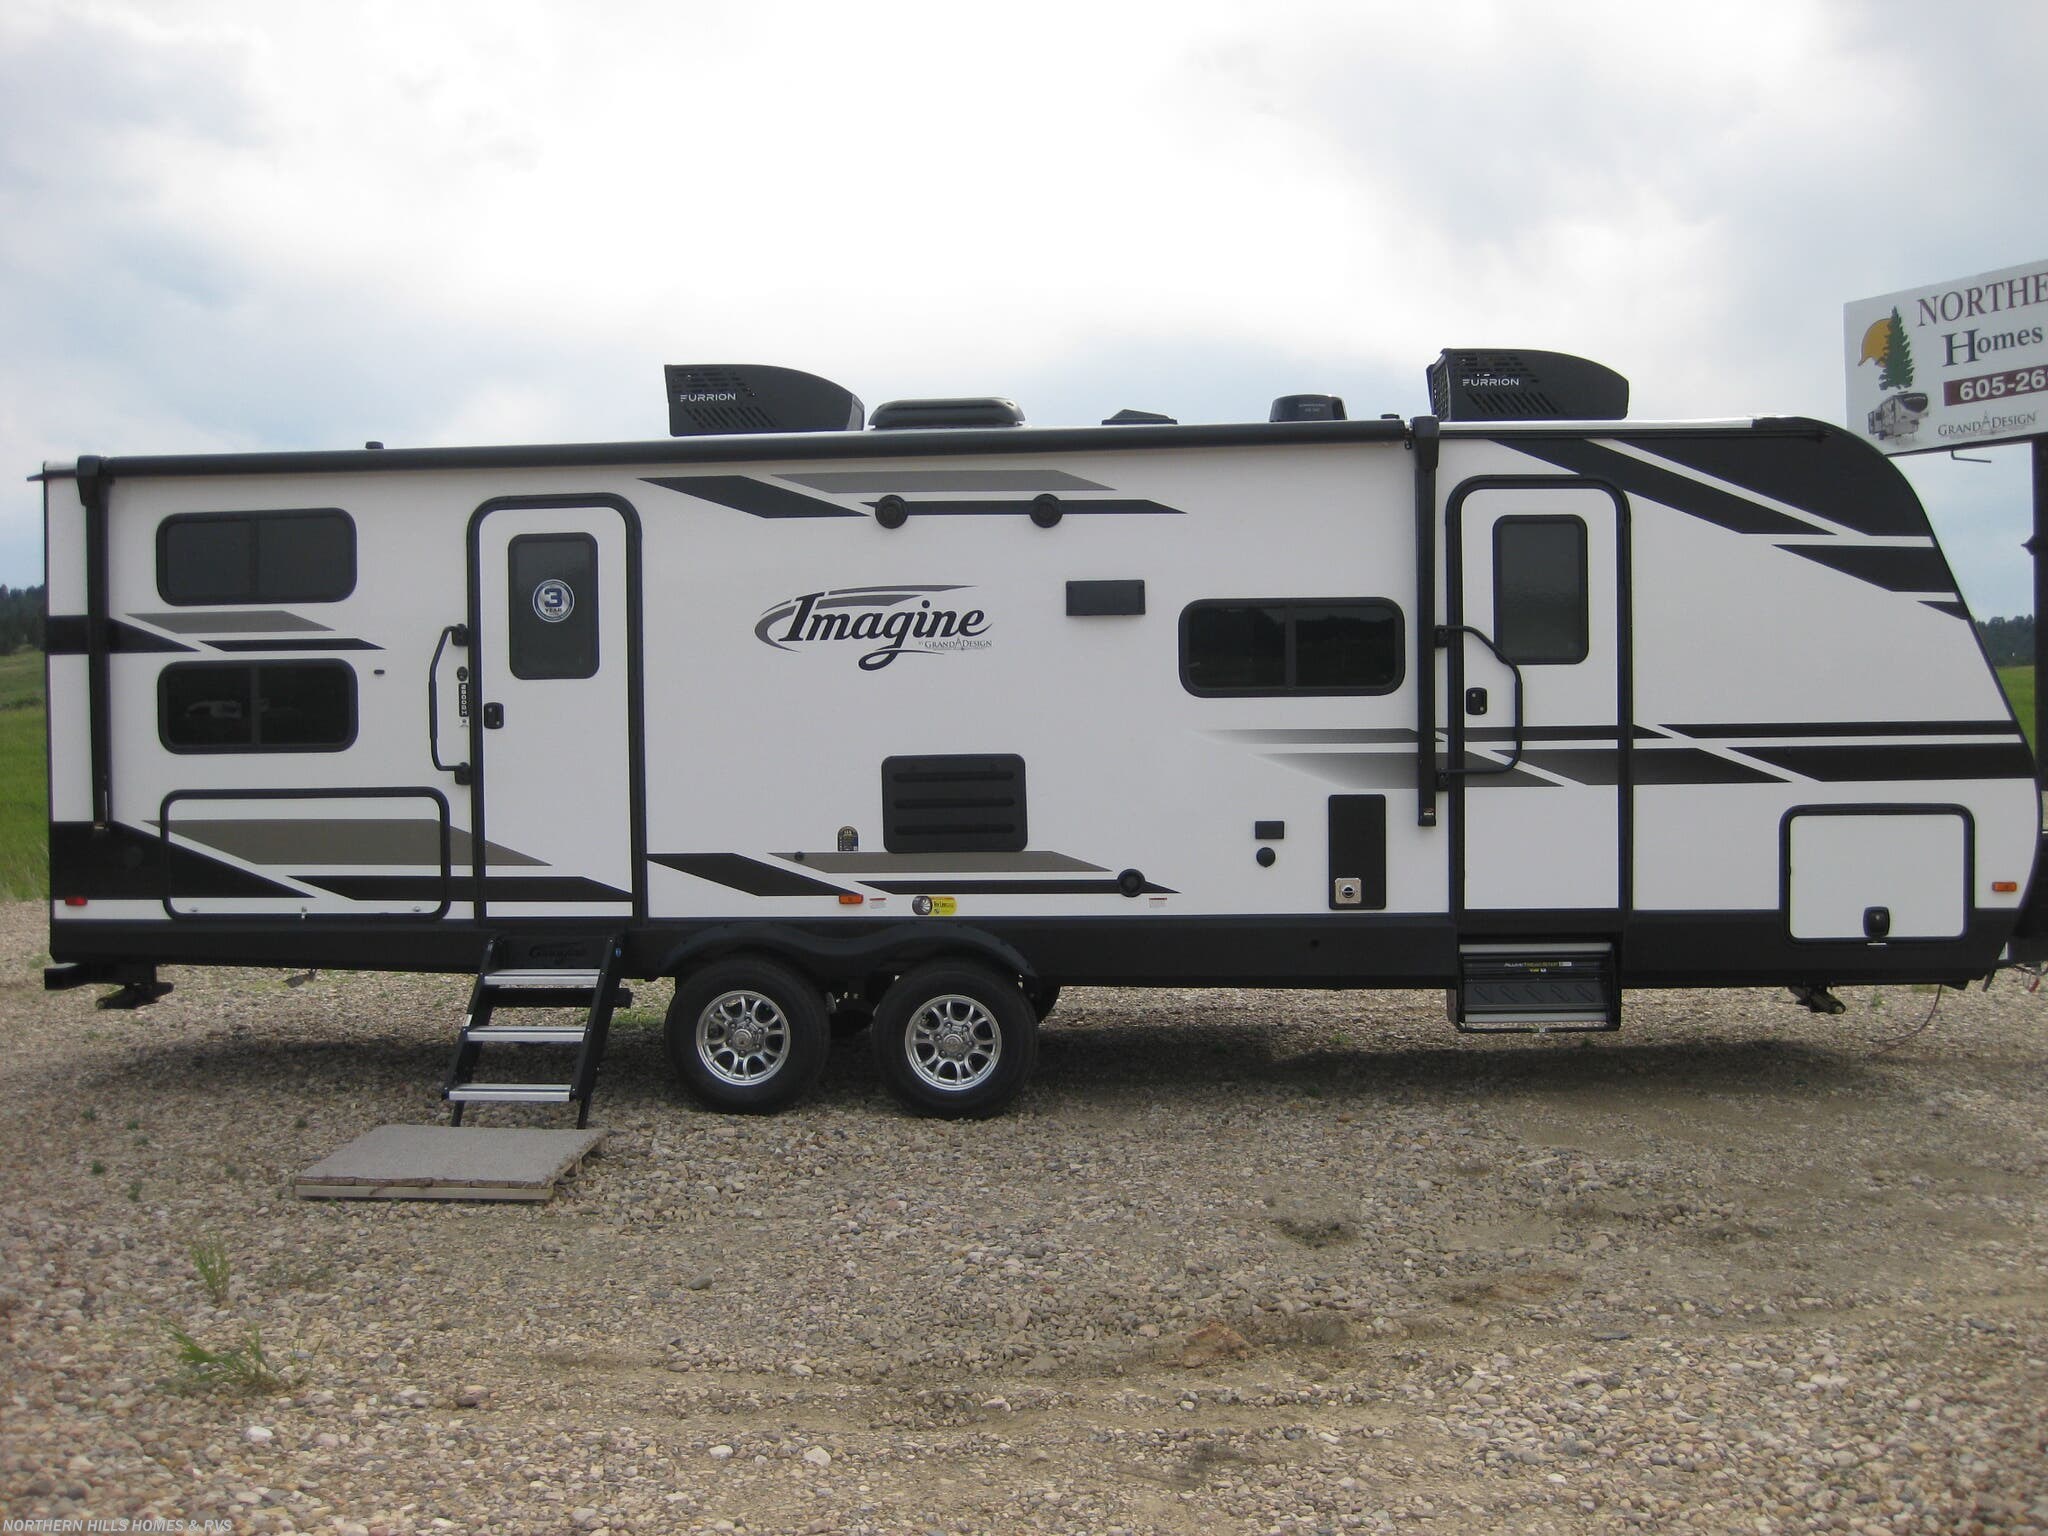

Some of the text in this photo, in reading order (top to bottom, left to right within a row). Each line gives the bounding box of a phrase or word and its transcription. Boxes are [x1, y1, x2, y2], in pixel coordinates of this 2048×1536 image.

[1916, 272, 2048, 328] NORTHE
[1941, 326, 2044, 367] Homes
[680, 392, 736, 403] FURRION
[1462, 377, 1519, 387] FURRION
[1959, 369, 2048, 401] 605-26
[544, 588, 563, 608] 3
[777, 591, 994, 671] Imagine
